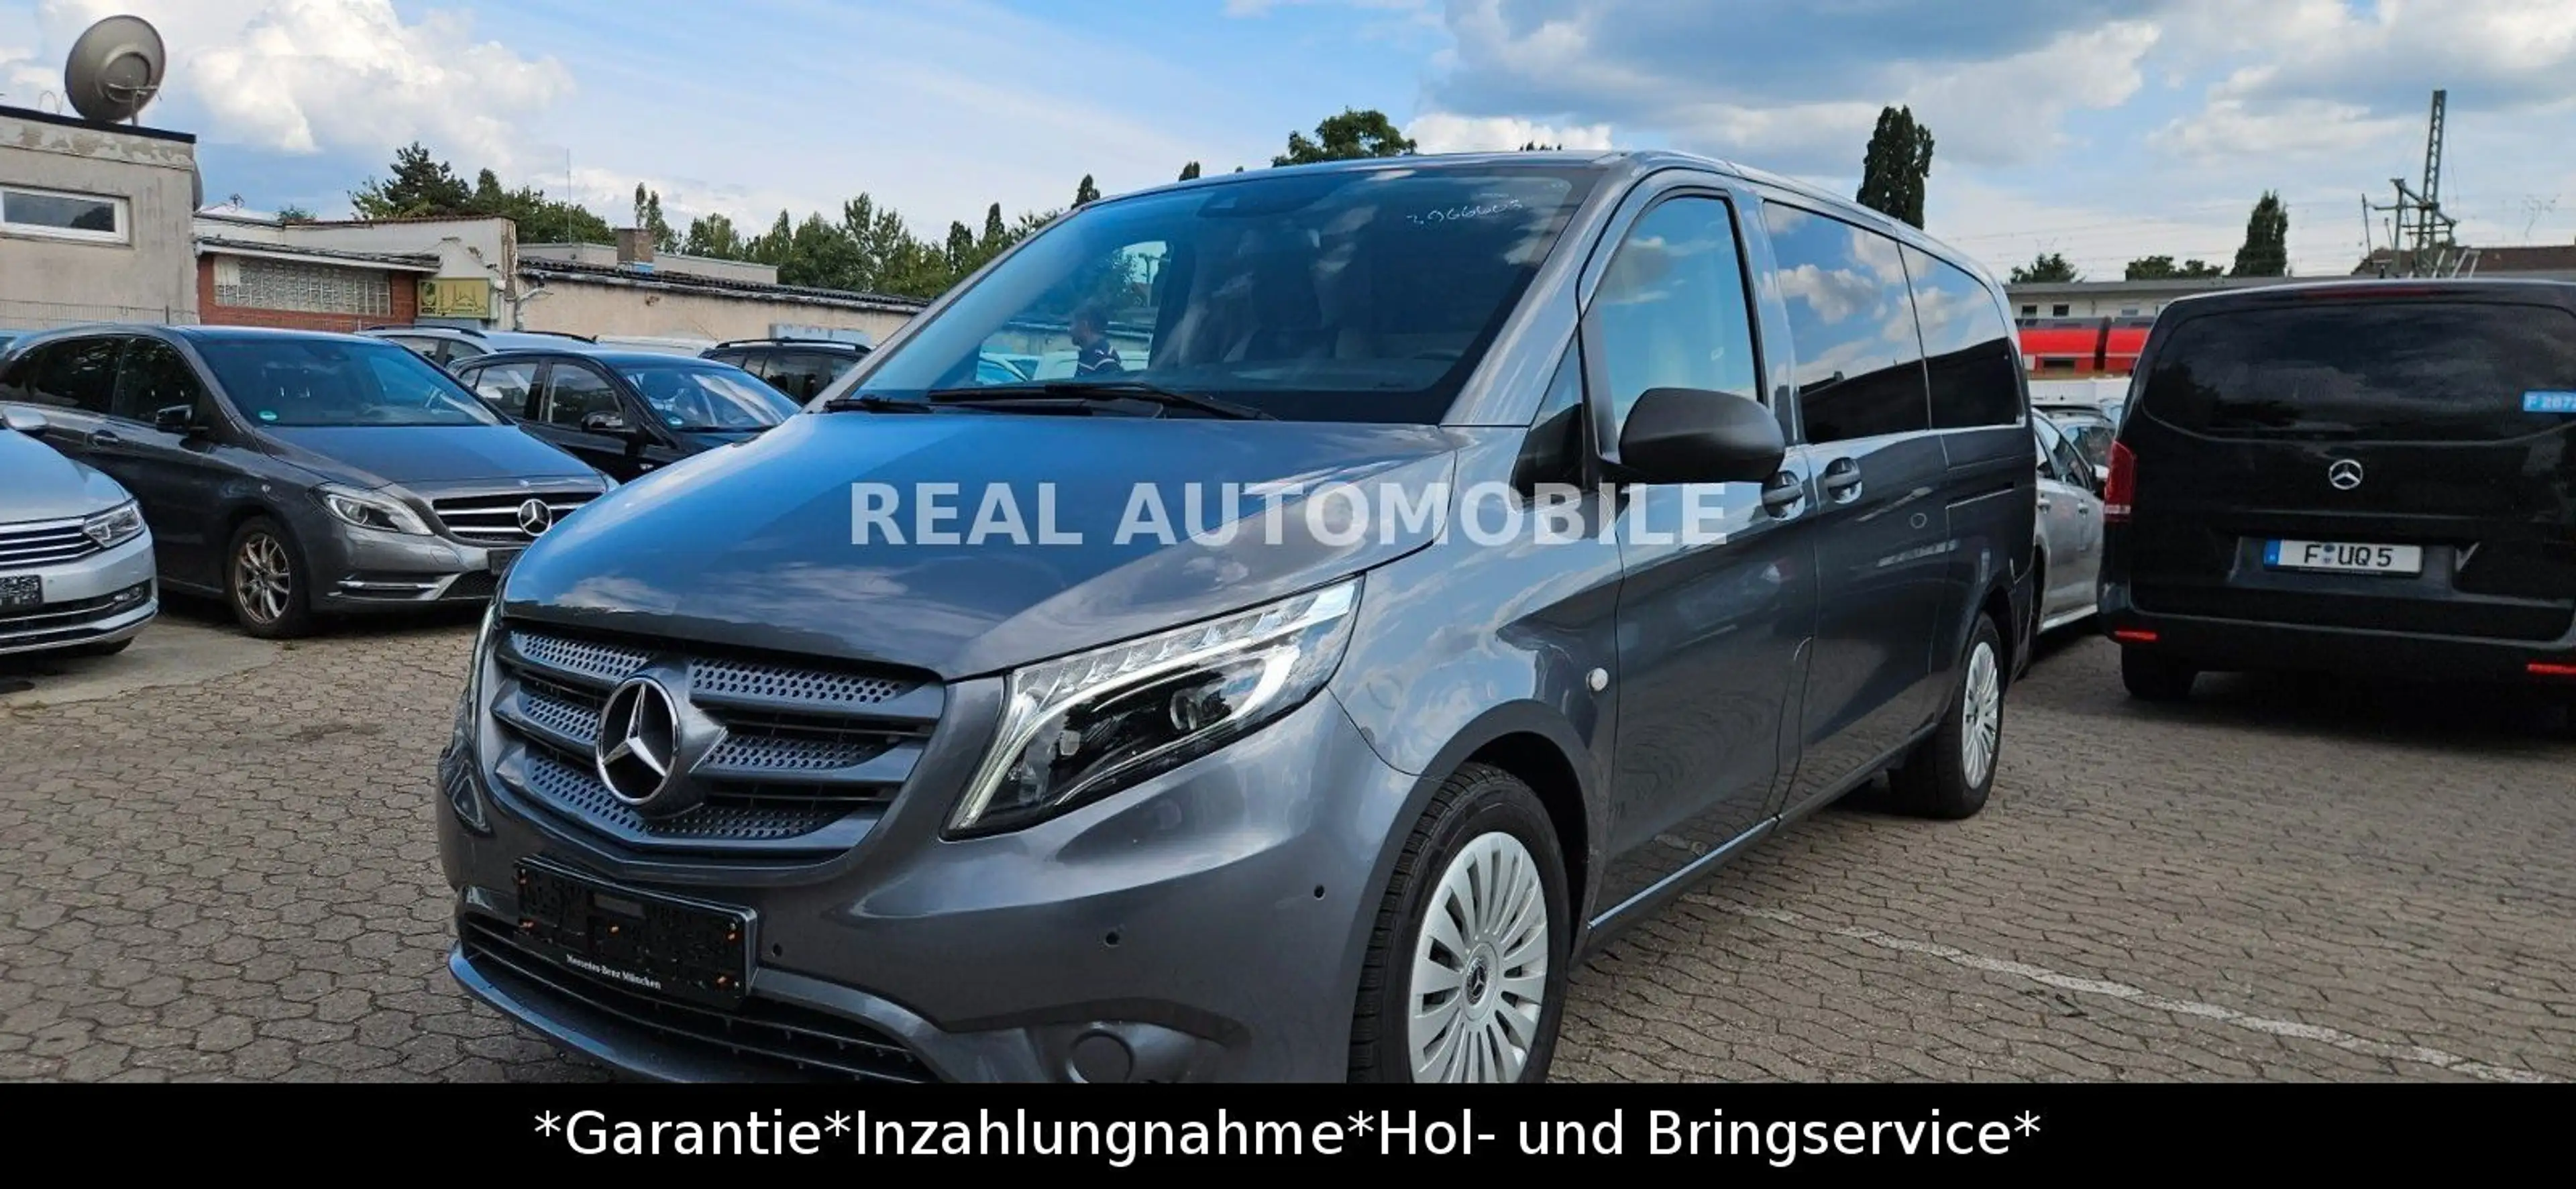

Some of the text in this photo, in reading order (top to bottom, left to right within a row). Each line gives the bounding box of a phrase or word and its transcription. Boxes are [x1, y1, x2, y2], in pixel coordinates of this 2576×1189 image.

[2304, 544, 2393, 567] F UQ 5
